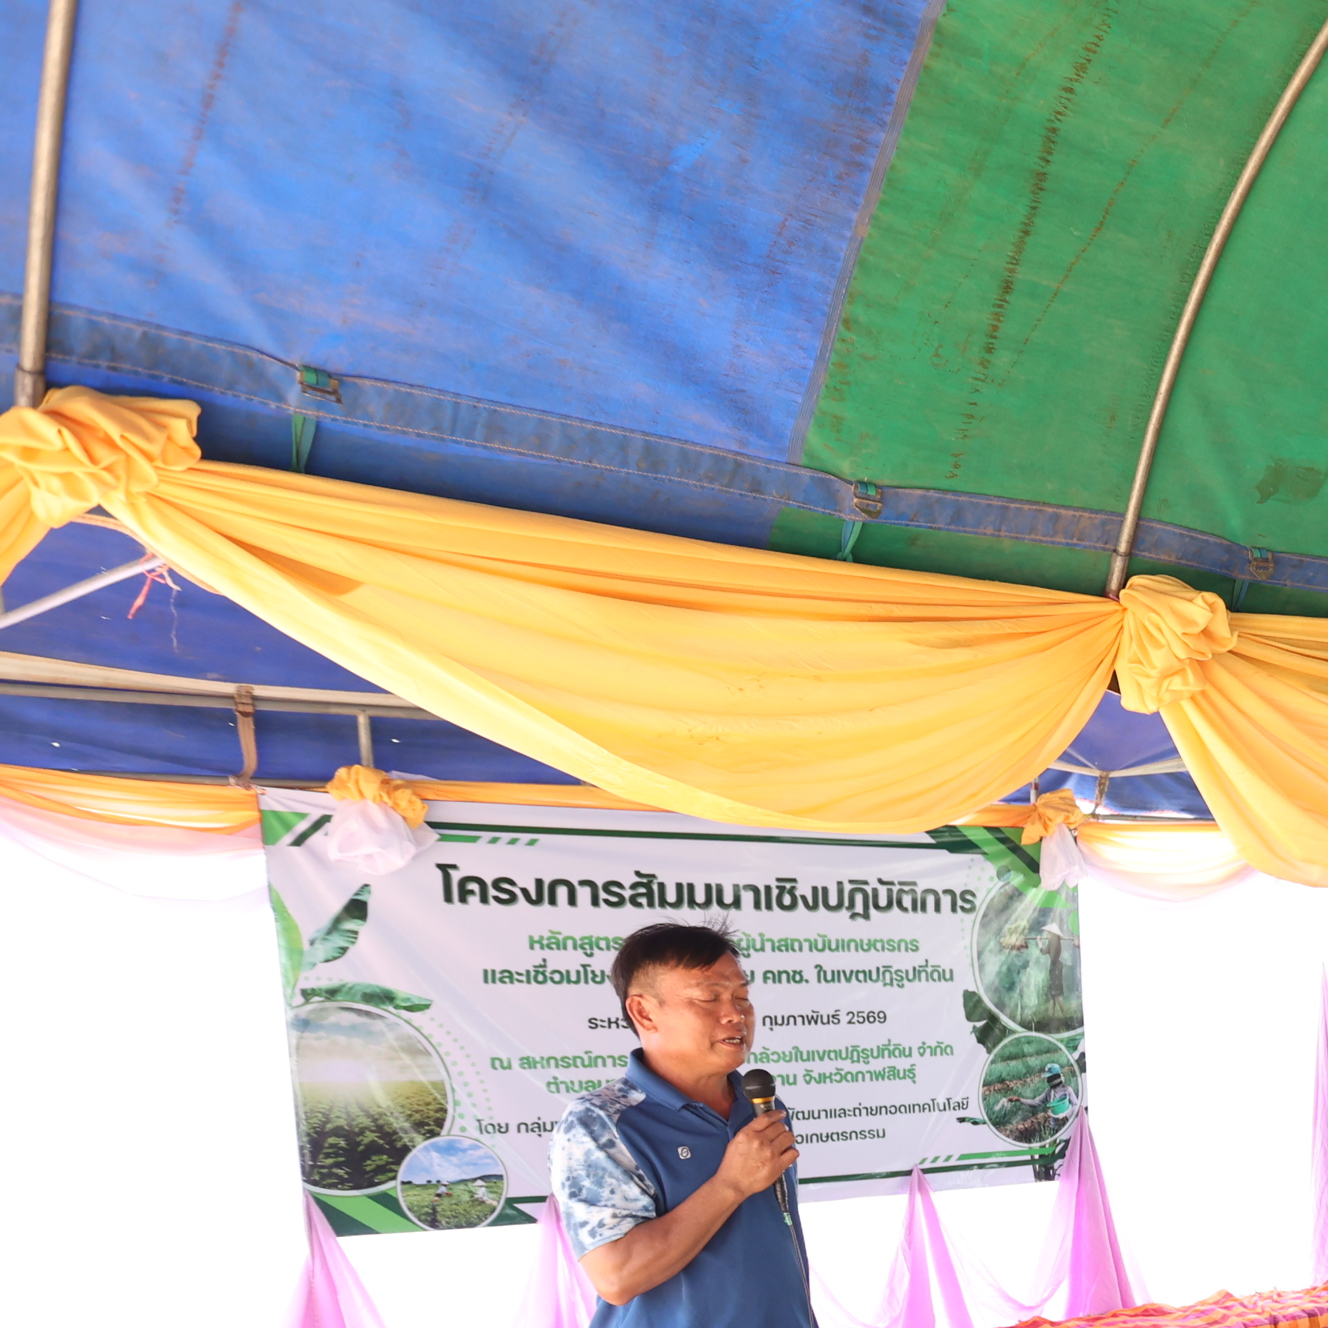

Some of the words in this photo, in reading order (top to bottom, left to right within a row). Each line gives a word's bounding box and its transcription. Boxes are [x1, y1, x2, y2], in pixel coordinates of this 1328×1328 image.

[730, 932, 920, 958] ผู้นำสถาบันเกษตรกร
[762, 1009, 841, 1031] กุมภาพันธ์
[846, 1010, 887, 1026] 2569
[917, 1041, 954, 1058] จำกัด
[476, 1118, 509, 1135] โดย
[516, 1116, 558, 1138] กลุ่ม
